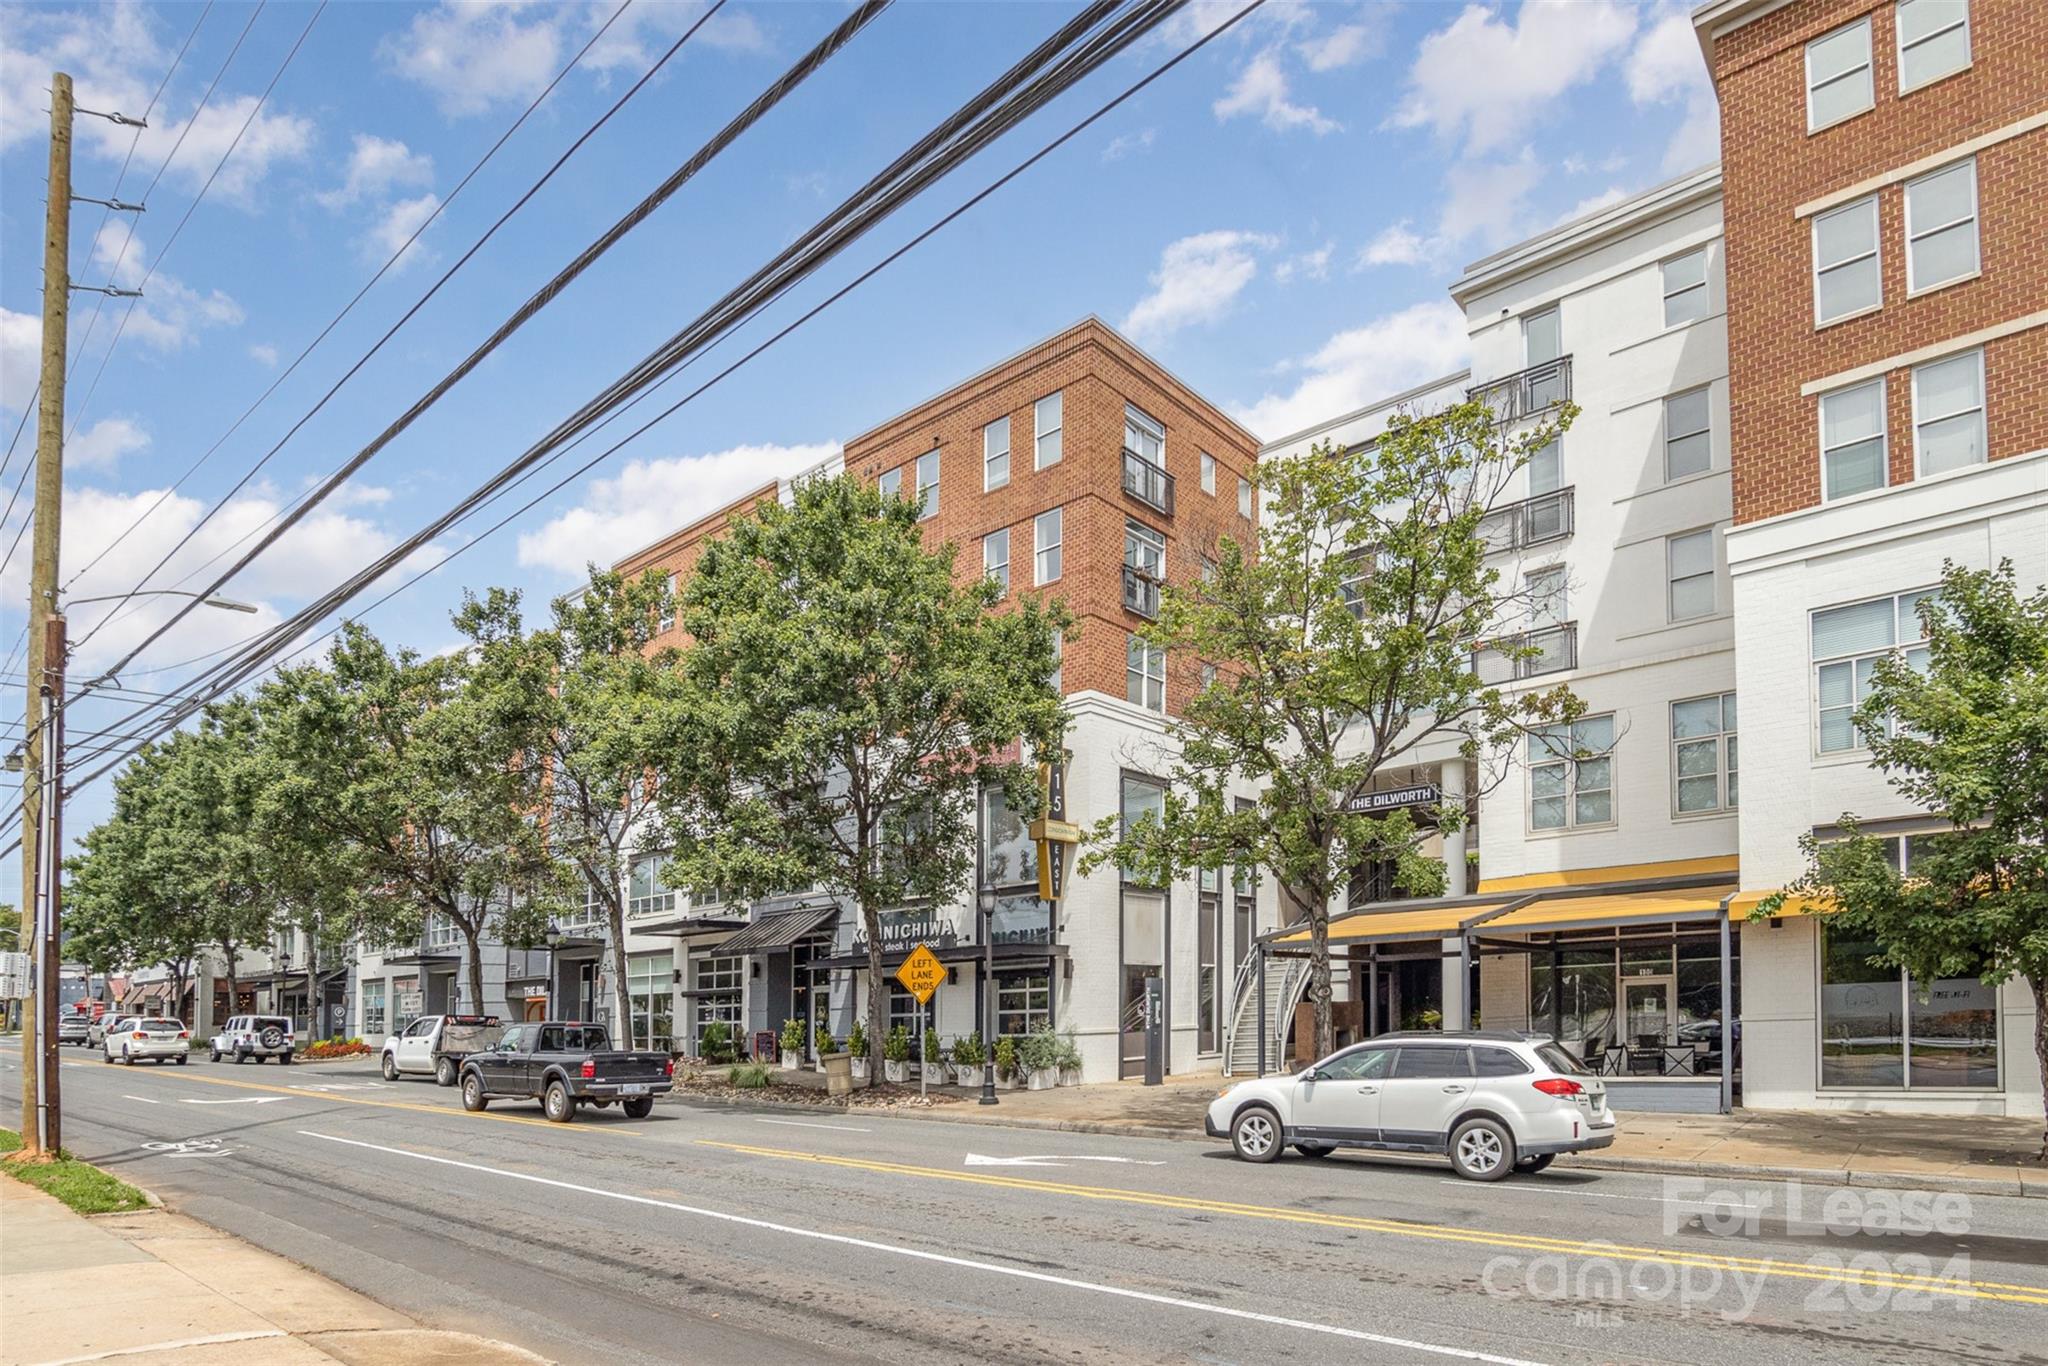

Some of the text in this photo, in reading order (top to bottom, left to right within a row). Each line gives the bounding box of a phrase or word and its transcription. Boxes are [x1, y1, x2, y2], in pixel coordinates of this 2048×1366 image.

[1352, 788, 1431, 810] THE DILWORTH
[1053, 844, 1061, 890] EAST
[852, 918, 954, 944] KONICHIWA
[885, 941, 904, 952] steak
[910, 938, 940, 949] sefood
[912, 959, 932, 968] LEFT
[911, 970, 934, 980] LANE
[523, 986, 535, 996] THE
[912, 982, 934, 991] ENDS
